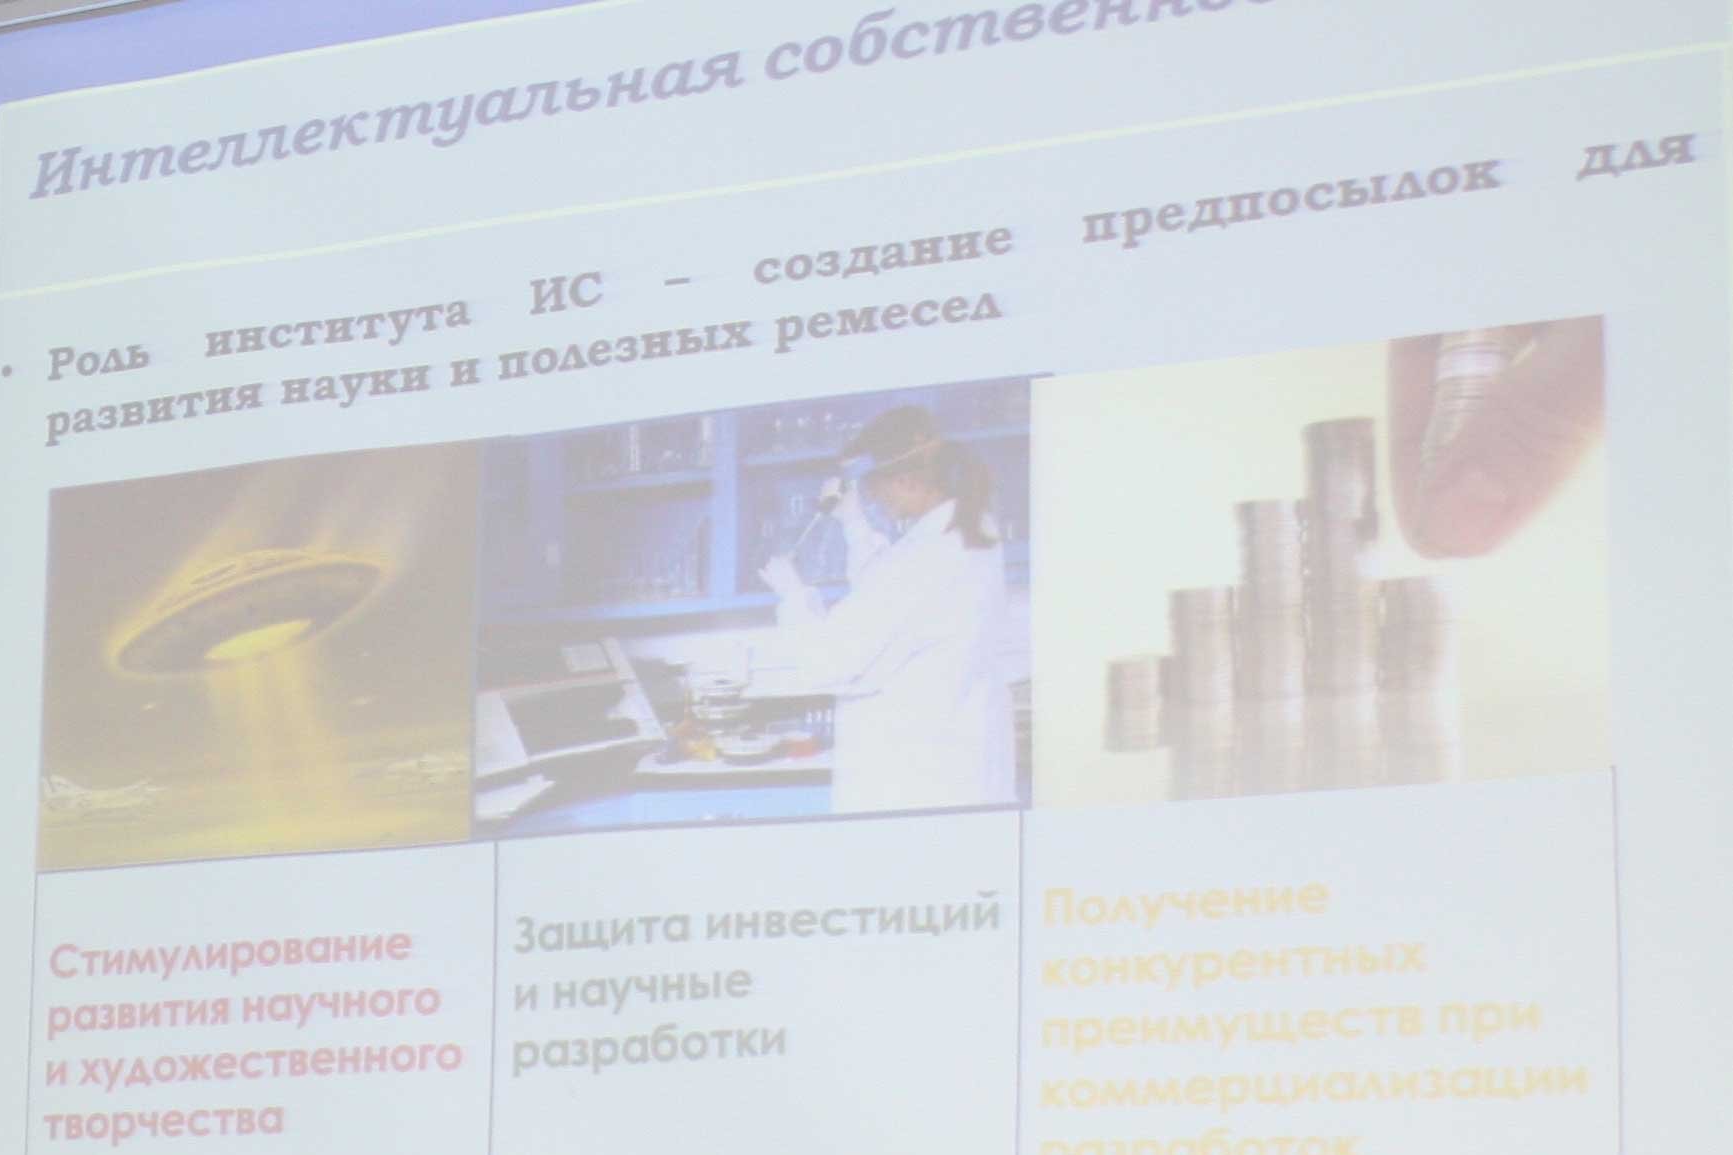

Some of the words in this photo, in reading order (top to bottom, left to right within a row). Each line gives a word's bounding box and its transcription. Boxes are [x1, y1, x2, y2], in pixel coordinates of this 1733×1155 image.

[29, 48, 745, 199] Интеллектуальная
[47, 341, 150, 381] Роль
[206, 297, 470, 358] института
[530, 272, 604, 314] ИС
[753, 224, 1013, 286] создание
[1081, 158, 1500, 249] предпосылок
[1576, 131, 1696, 182] для
[44, 381, 262, 447] развития
[280, 367, 429, 410] науки
[450, 358, 479, 388] и
[499, 320, 753, 381] полезных
[774, 291, 1003, 355] ремесел
[514, 911, 691, 956] Защита
[705, 890, 1001, 936] инвестиций
[1042, 879, 1331, 931] Получение
[49, 931, 413, 979] Стимулирование
[1041, 941, 1428, 992] конкурентных
[47, 995, 230, 1040] развития
[242, 984, 441, 1029] научного
[515, 983, 538, 1011] и
[552, 968, 753, 1014] научные
[513, 1023, 788, 1076] разработки
[1041, 1002, 1423, 1054] преимуществ
[1437, 996, 1541, 1041] при
[45, 1062, 67, 1086] и
[80, 1042, 463, 1093] художественного
[1039, 1062, 1590, 1113] коммерциализации
[44, 1104, 285, 1146] творчества
